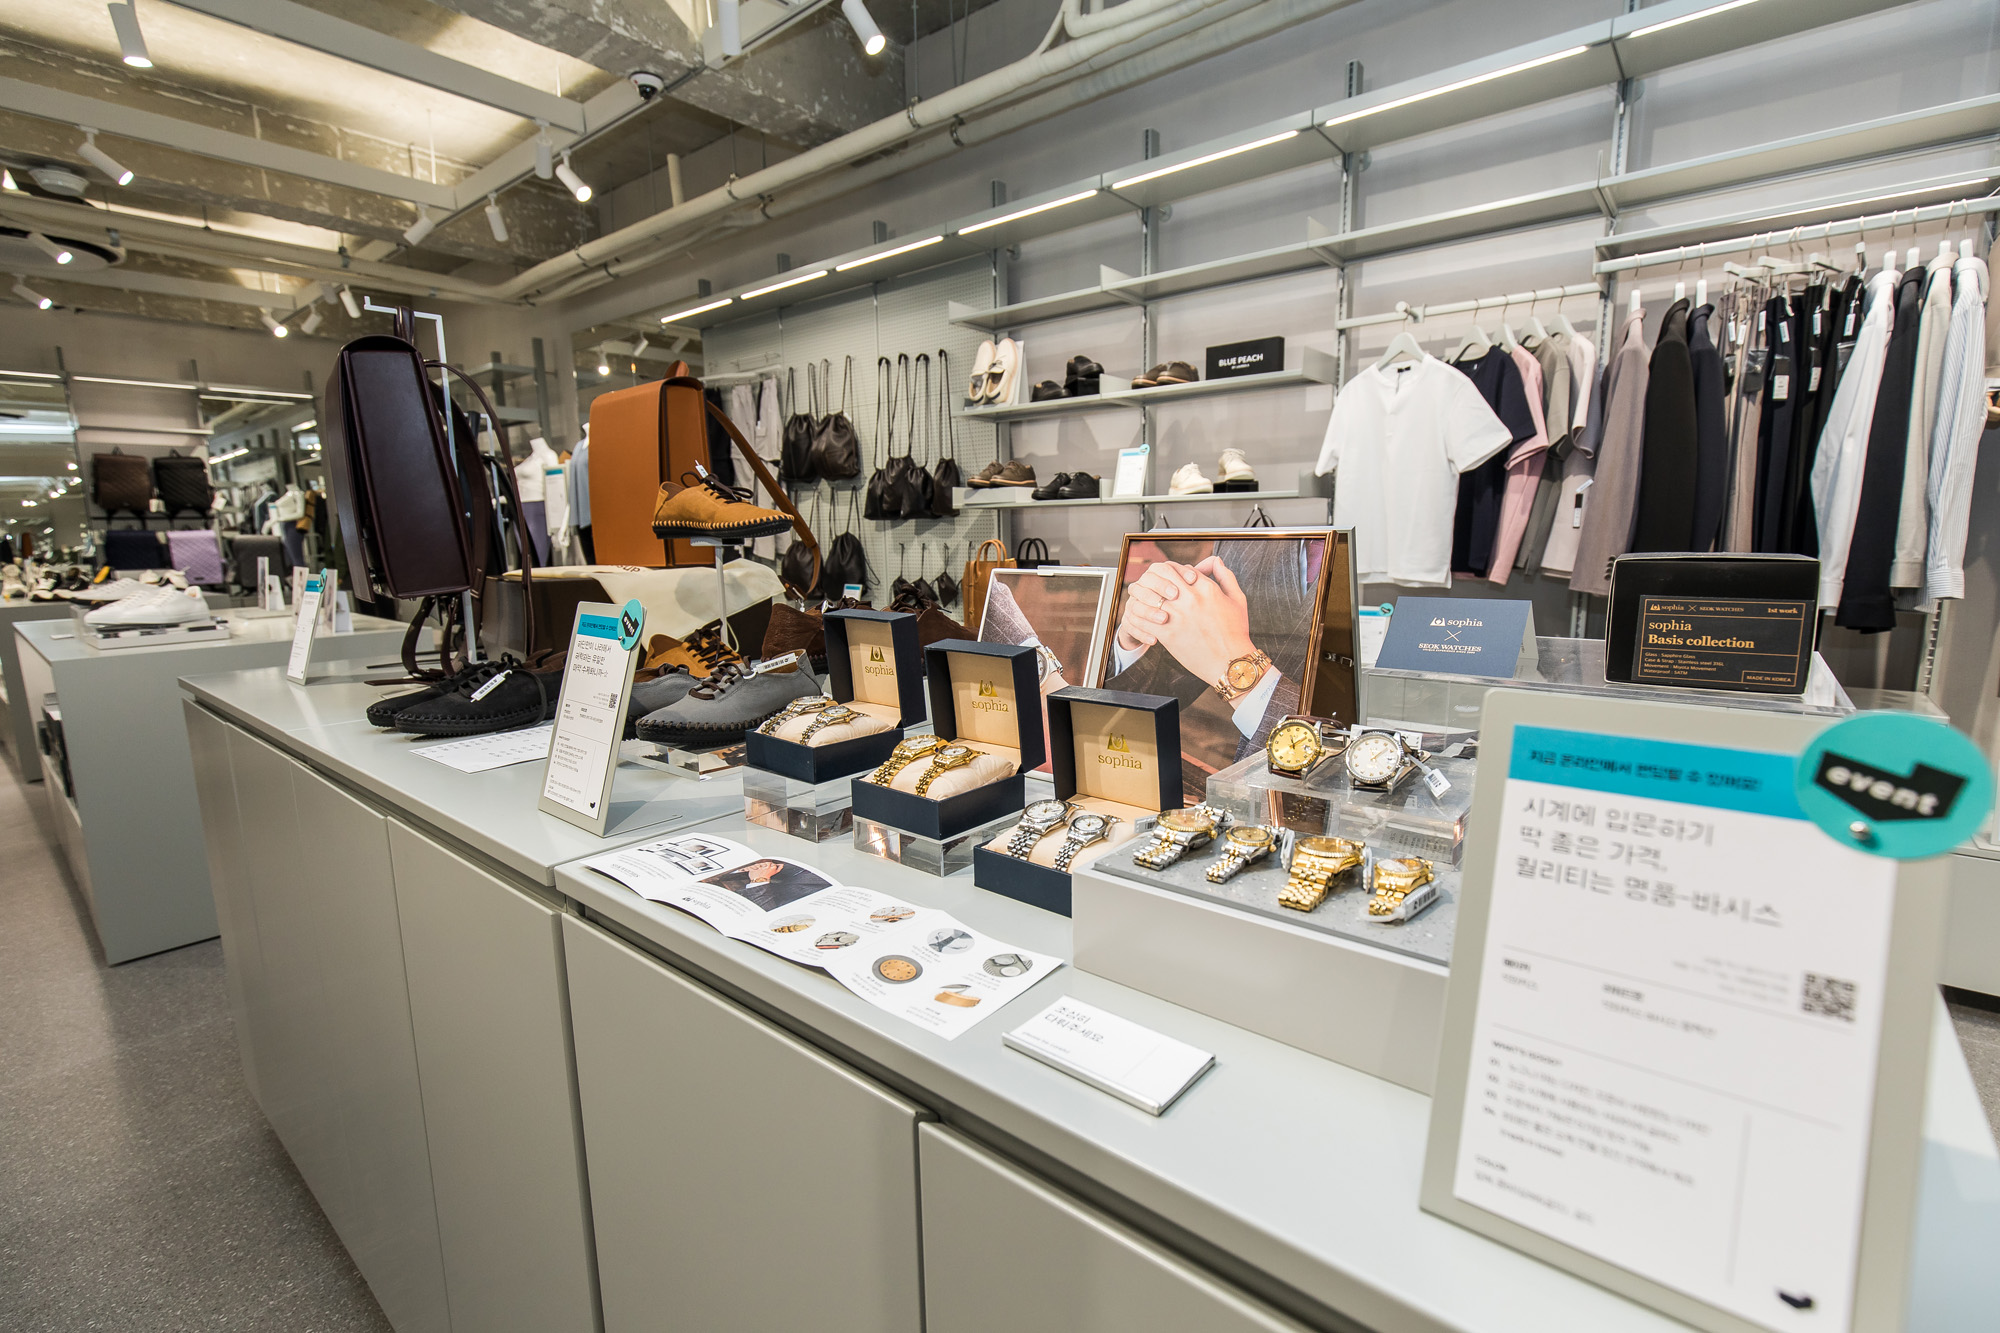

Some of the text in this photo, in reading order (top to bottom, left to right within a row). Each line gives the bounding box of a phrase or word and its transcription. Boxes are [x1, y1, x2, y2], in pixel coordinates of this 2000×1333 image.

[1218, 353, 1264, 367] BLUE PEACH
[623, 616, 634, 636] event
[1447, 618, 1483, 628] sophia
[1649, 620, 1692, 632] sophia
[1441, 644, 1482, 652] WATCHES
[1648, 634, 1755, 648] Basis collection
[864, 664, 895, 677] sophia
[972, 698, 1009, 714] sophia
[1098, 754, 1143, 770] sophia
[1825, 766, 1940, 816] event
[1523, 797, 1715, 847] 시계에 입문하기
[1520, 825, 1542, 848] 딱
[1551, 830, 1600, 860] 좋은
[1516, 855, 1614, 896] 퀄리티는
[1054, 1006, 1091, 1024] 조심히
